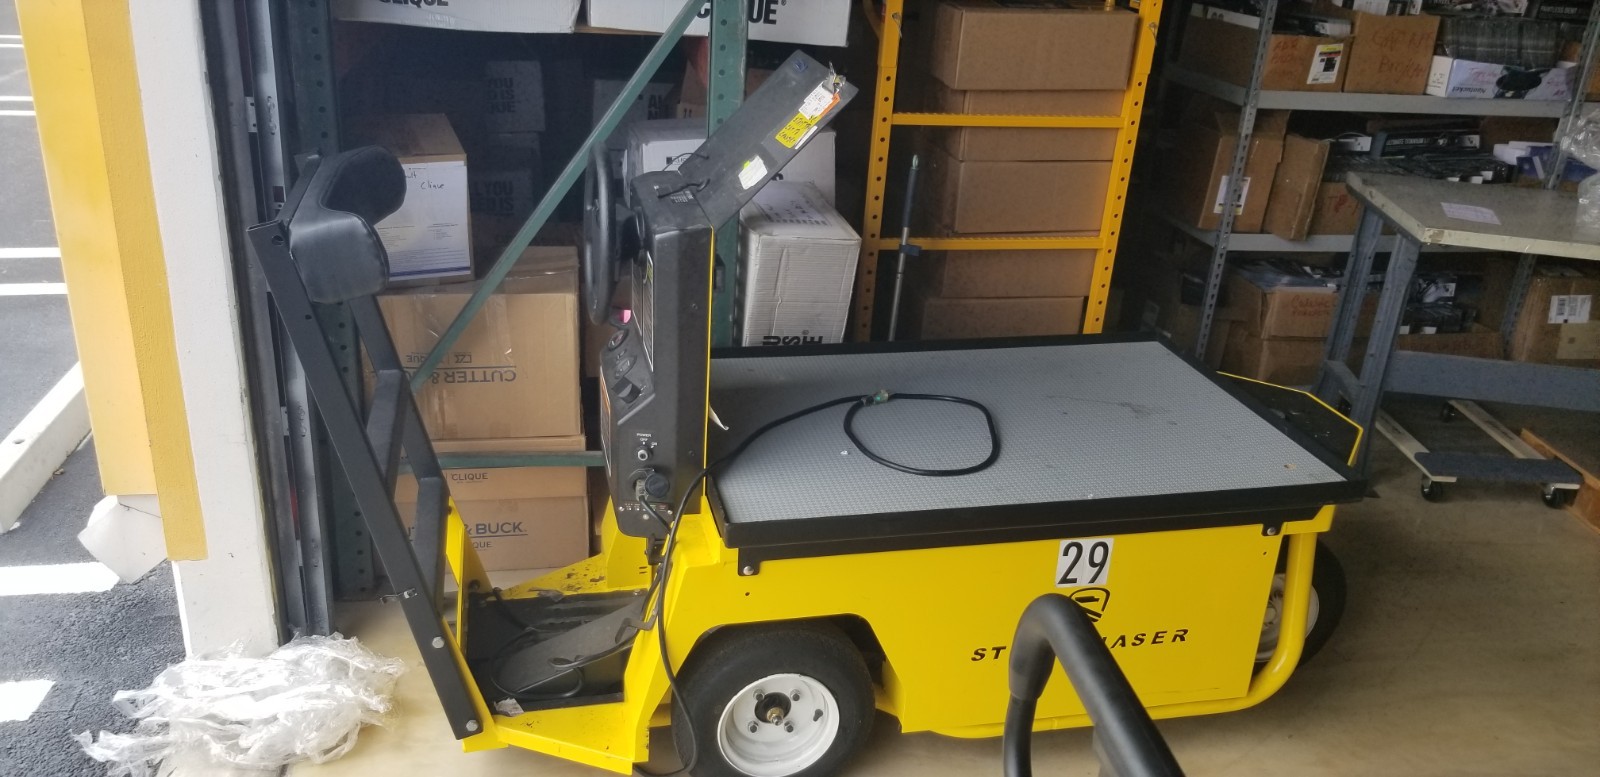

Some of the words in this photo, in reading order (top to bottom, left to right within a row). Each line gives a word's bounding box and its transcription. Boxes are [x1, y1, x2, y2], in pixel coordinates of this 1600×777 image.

[444, 370, 517, 384] CUTTER
[451, 472, 488, 481] CLIQUE
[1057, 541, 1109, 585] 29
